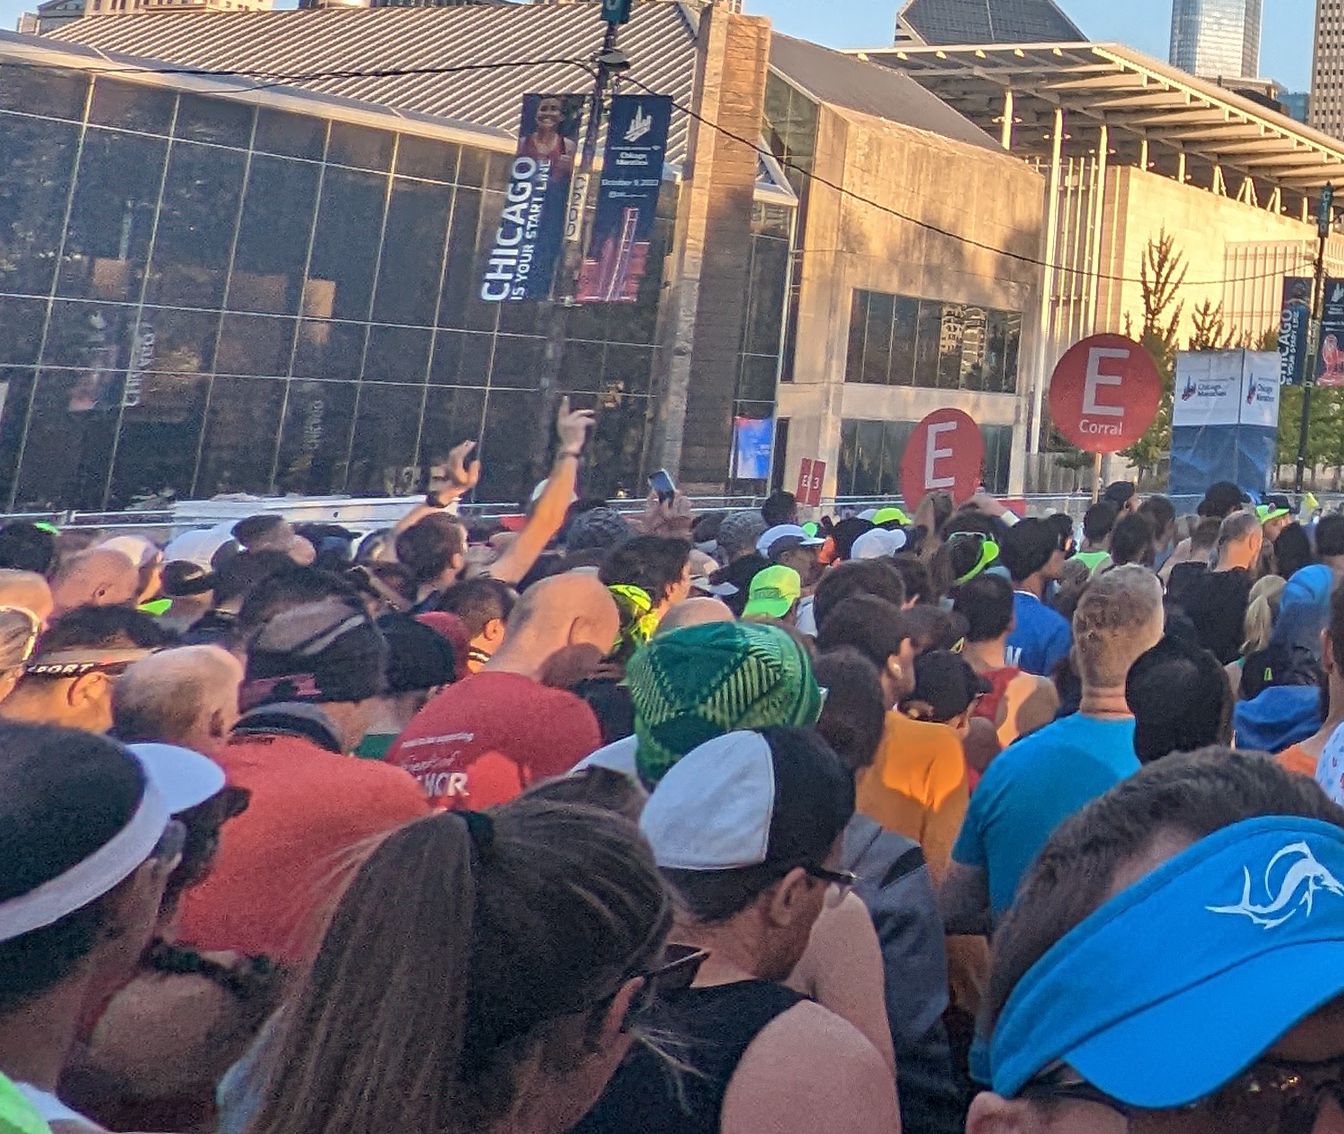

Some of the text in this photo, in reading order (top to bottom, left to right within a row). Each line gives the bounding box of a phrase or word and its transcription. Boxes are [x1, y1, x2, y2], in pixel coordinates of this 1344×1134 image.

[481, 156, 537, 302] CHICAGO
[510, 159, 551, 301] IS YOUR START LINE
[1081, 347, 1131, 417] E
[924, 420, 958, 490] E
[1079, 419, 1123, 436] Corral
